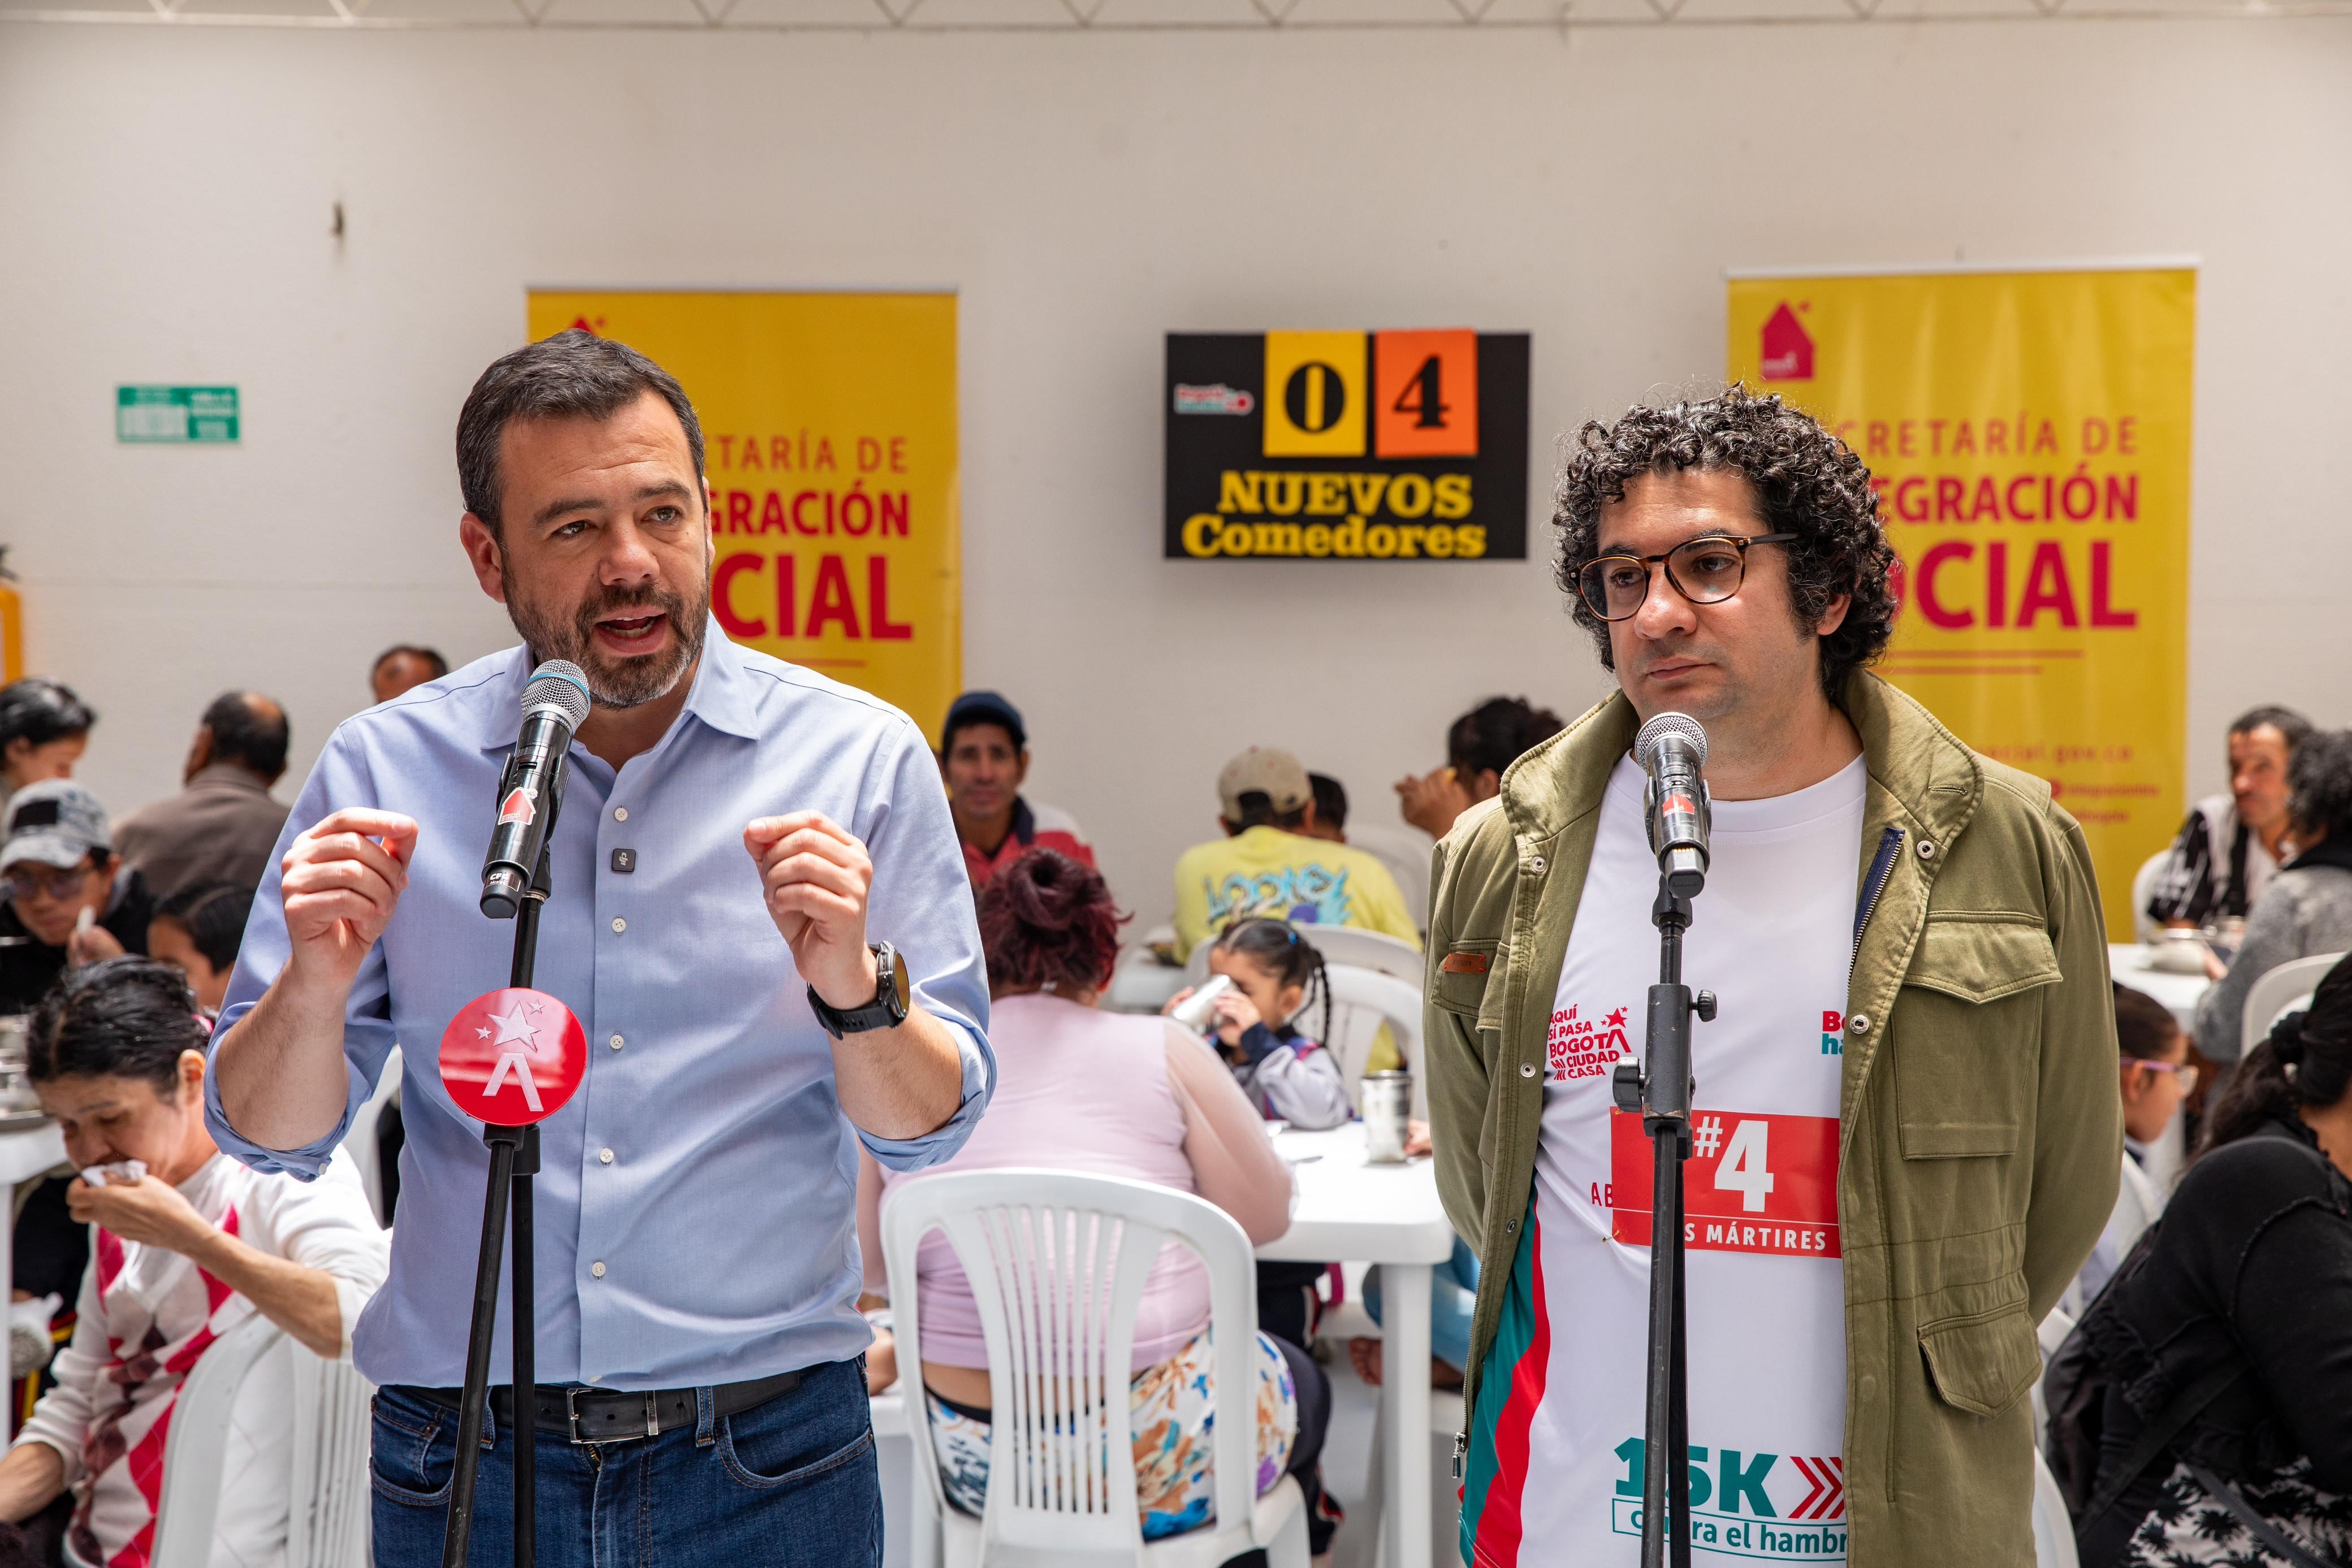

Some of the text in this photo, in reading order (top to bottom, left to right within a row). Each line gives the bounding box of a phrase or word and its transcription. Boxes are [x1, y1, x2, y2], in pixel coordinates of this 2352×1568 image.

[705, 427, 908, 474] TARÍA DE
[2082, 417, 2139, 456] DE
[1217, 470, 1473, 518] NUEVOS
[1181, 513, 1488, 558] Comedores
[712, 552, 913, 640] CIAL
[1550, 1004, 1578, 1024] AQUÍ
[1548, 1021, 1593, 1041] SÍ PASA
[1551, 1050, 1620, 1069] MI CIUDAD
[1568, 1064, 1606, 1078] CASA
[1706, 1221, 1826, 1250] MÁRTIRES
[1726, 1522, 1751, 1549] el
